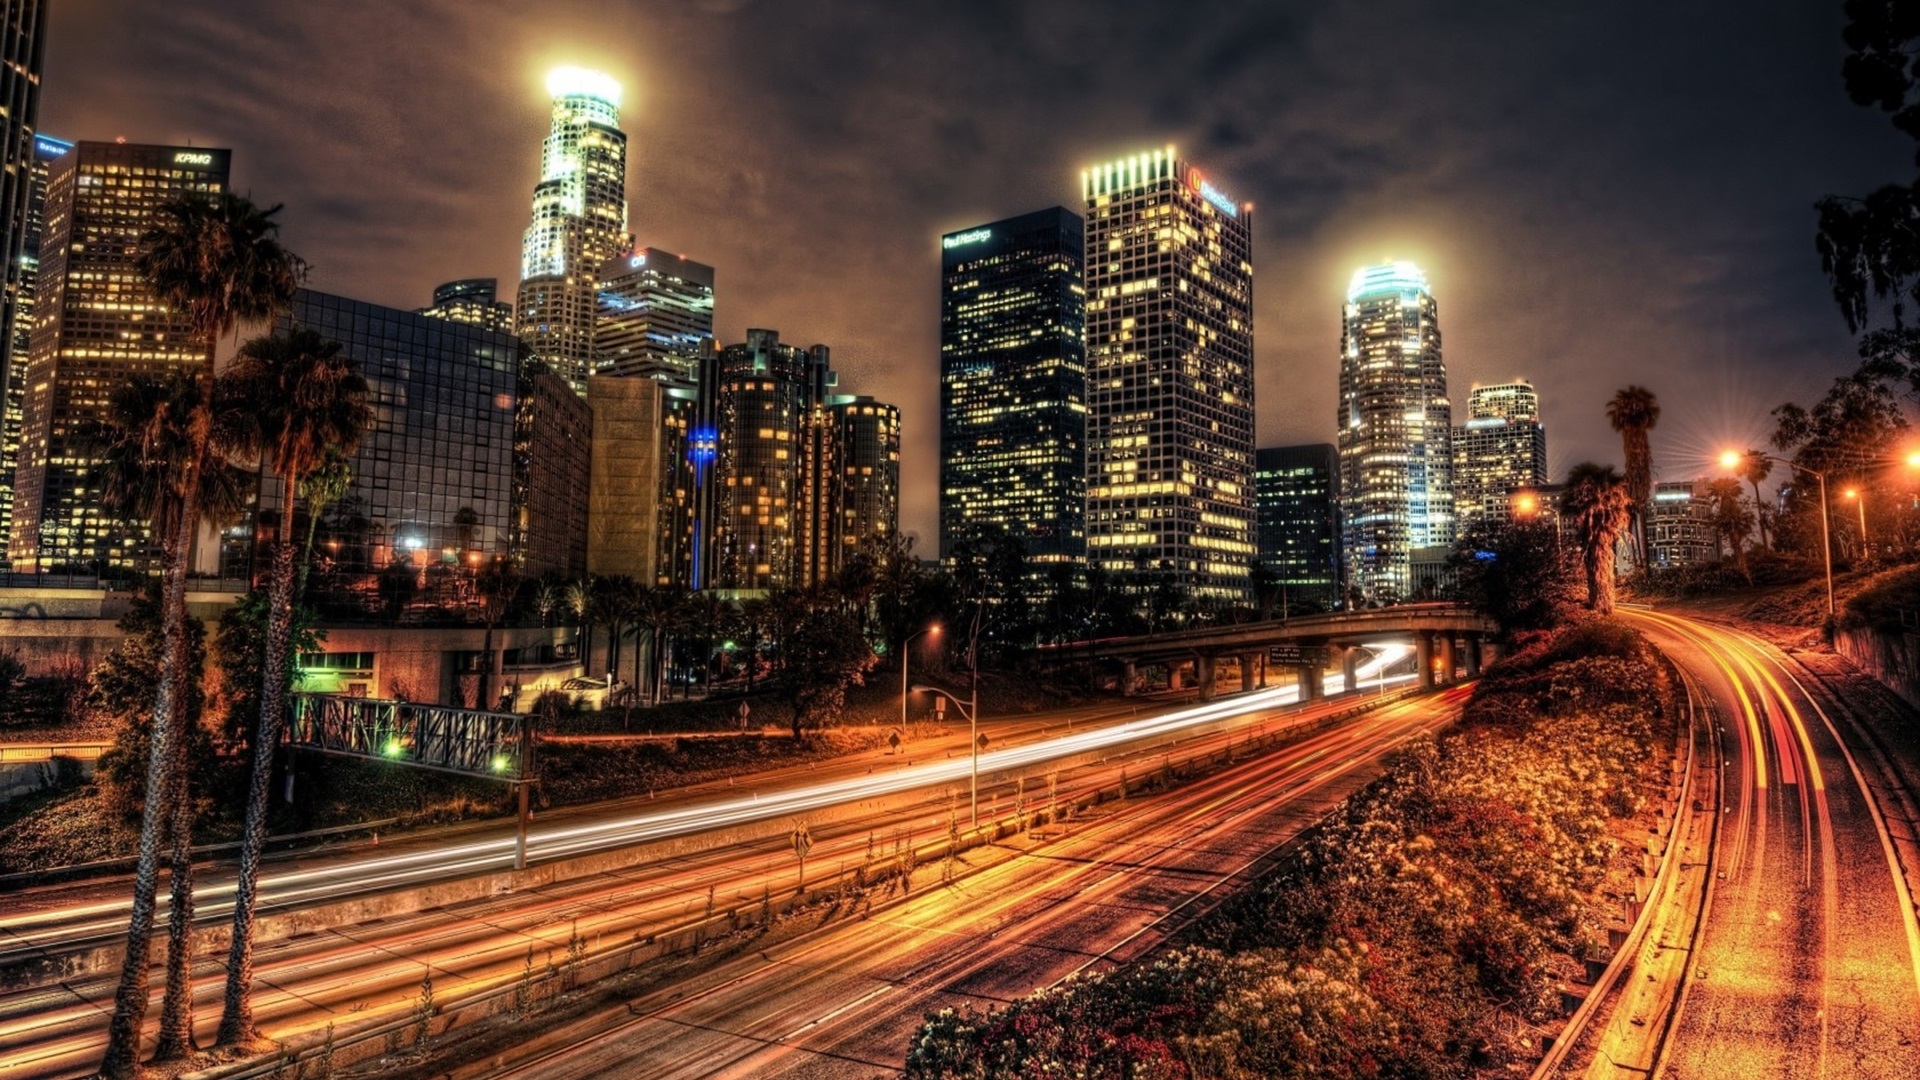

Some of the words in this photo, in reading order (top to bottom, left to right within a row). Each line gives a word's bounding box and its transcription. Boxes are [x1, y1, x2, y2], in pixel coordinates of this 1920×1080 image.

[174, 153, 212, 165] KPMG
[943, 235, 960, 249] Paul
[960, 229, 991, 244] Hastings
